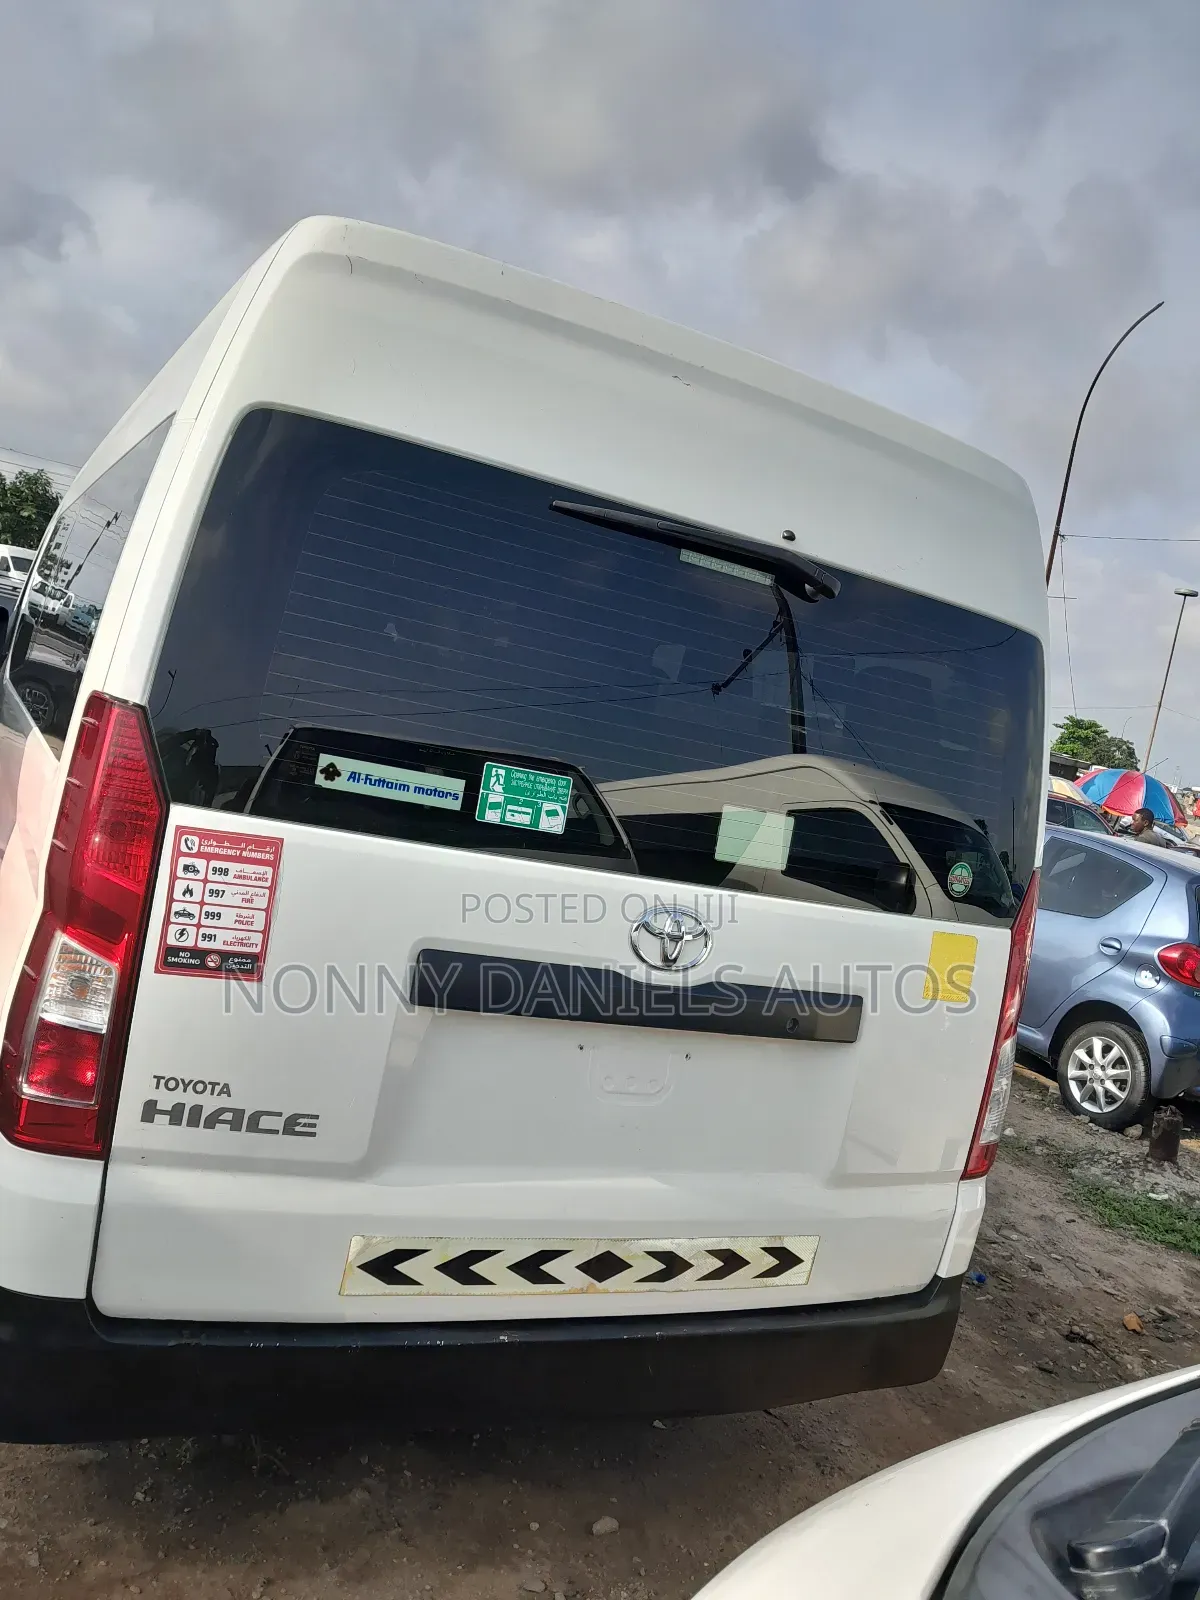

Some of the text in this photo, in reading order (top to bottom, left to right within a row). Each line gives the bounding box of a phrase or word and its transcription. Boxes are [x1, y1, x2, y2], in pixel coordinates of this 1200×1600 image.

[346, 771, 460, 801] Al-Futtaim motors
[200, 845, 275, 861] EMERGENCY NUMBERS
[211, 866, 230, 877] 998
[232, 873, 270, 883] AMBULANCE
[208, 888, 226, 899] 997
[241, 897, 255, 905] FIRE
[203, 910, 222, 921] 999
[233, 918, 255, 927] POLICE
[200, 932, 217, 943] 991
[222, 940, 259, 949] ELECTRICITY
[167, 956, 201, 965] SMOKING
[153, 1075, 232, 1098] TOYOTA
[140, 1099, 320, 1138] HIACE
